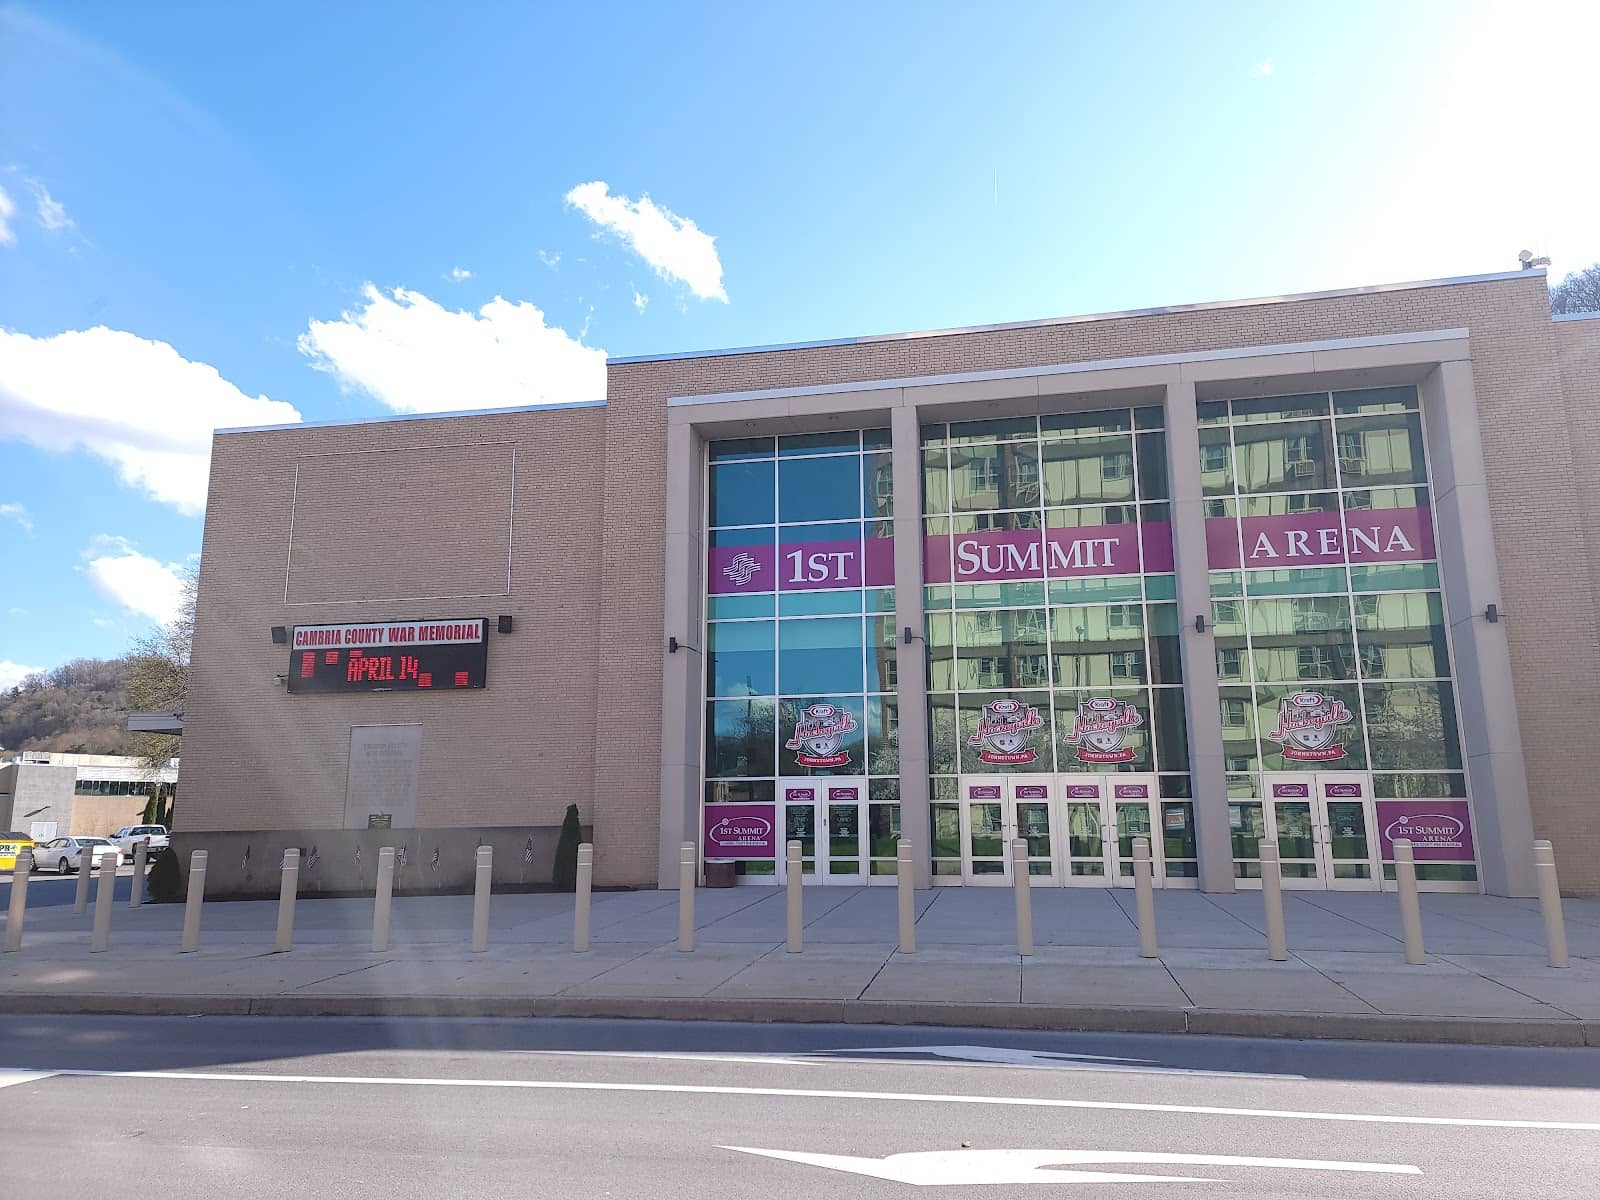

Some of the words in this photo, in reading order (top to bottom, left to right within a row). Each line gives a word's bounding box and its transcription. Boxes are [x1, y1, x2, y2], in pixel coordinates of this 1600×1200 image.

[786, 549, 854, 583] 1ST
[957, 538, 1120, 575] SUMMIT
[1250, 525, 1415, 559] ARENA
[295, 629, 342, 647] CAMBRIA
[344, 627, 385, 644] COUNTY
[388, 625, 415, 643] WAR
[418, 623, 480, 641] MEMORIAL
[347, 655, 394, 682] APRIL
[399, 655, 419, 681] 14
[733, 826, 764, 835] SUMMIT
[1397, 826, 1415, 835] 1ST
[1415, 825, 1455, 835] SUMMIT
